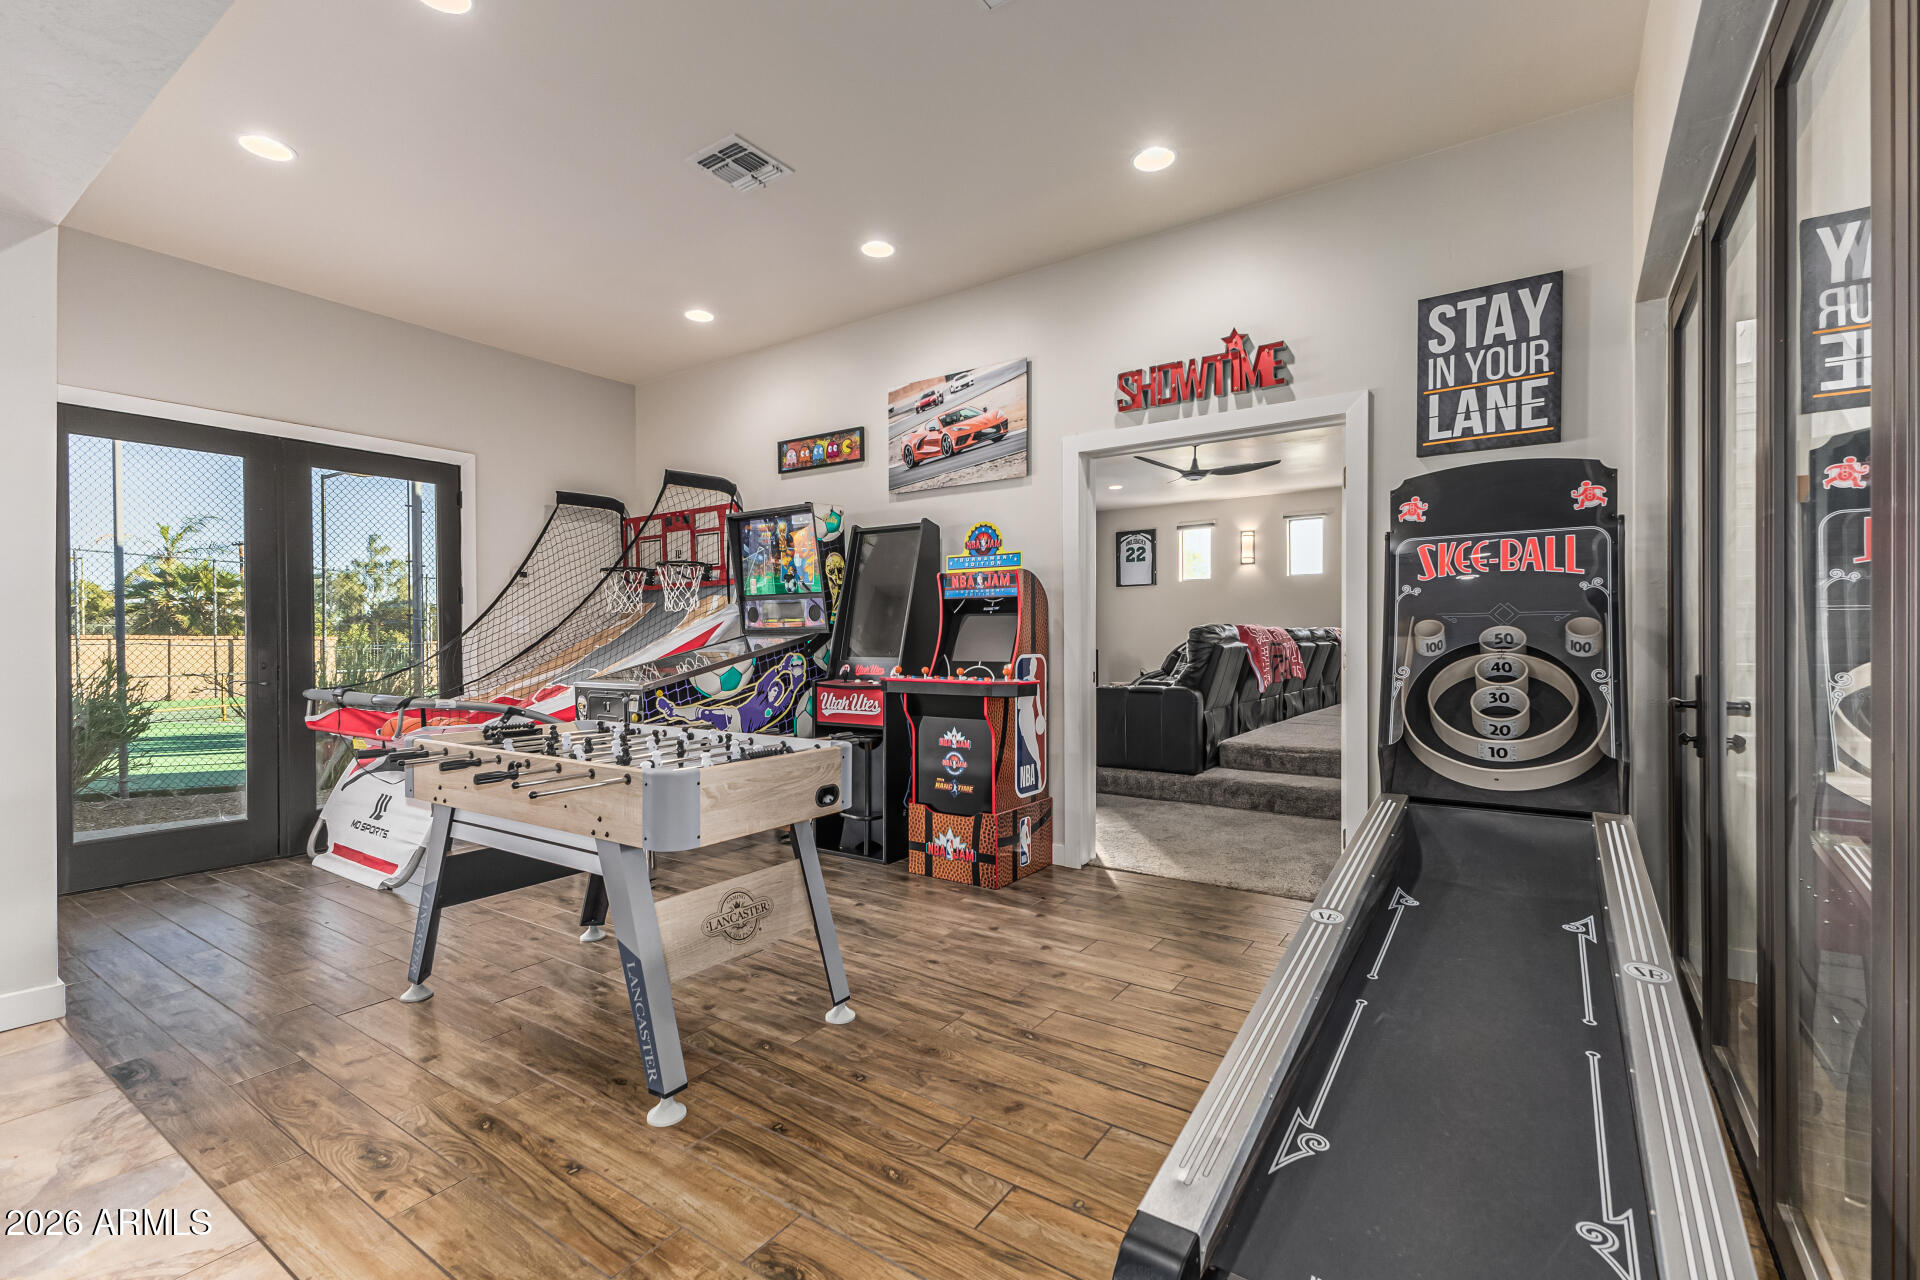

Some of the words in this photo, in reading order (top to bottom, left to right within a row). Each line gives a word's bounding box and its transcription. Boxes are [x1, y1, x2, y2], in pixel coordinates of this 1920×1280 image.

[1428, 283, 1553, 354] STAY
[1117, 328, 1287, 412] SHOWTIME
[1428, 355, 1455, 390] IN
[1465, 339, 1550, 383] YOUR
[1428, 377, 1549, 441] LANE
[965, 540, 980, 550] NBA
[985, 538, 1002, 549] JAM
[954, 554, 1014, 563] TOURNAMENT
[1125, 546, 1146, 562] 22
[1417, 534, 1586, 581] SKEE-BALL
[951, 574, 975, 589] NBA
[984, 572, 1011, 587] JAM
[1426, 639, 1443, 653] 100
[1494, 633, 1514, 645] 50
[1570, 640, 1592, 653] 100
[1490, 661, 1513, 673] 40
[820, 692, 850, 711] Utah
[850, 693, 881, 713] Utes
[1488, 691, 1510, 704] 30
[1489, 723, 1511, 736] 20
[939, 737, 952, 747] NBA
[1488, 746, 1508, 759] 10
[1020, 764, 1036, 788] NBA
[935, 782, 953, 791] HANG
[957, 784, 974, 793] TIME
[360, 822, 390, 839] SPORTS
[926, 841, 946, 858] NBA
[953, 847, 975, 863] JAM
[708, 902, 768, 932] LANCASTER
[626, 961, 658, 1083] LANCASTER
